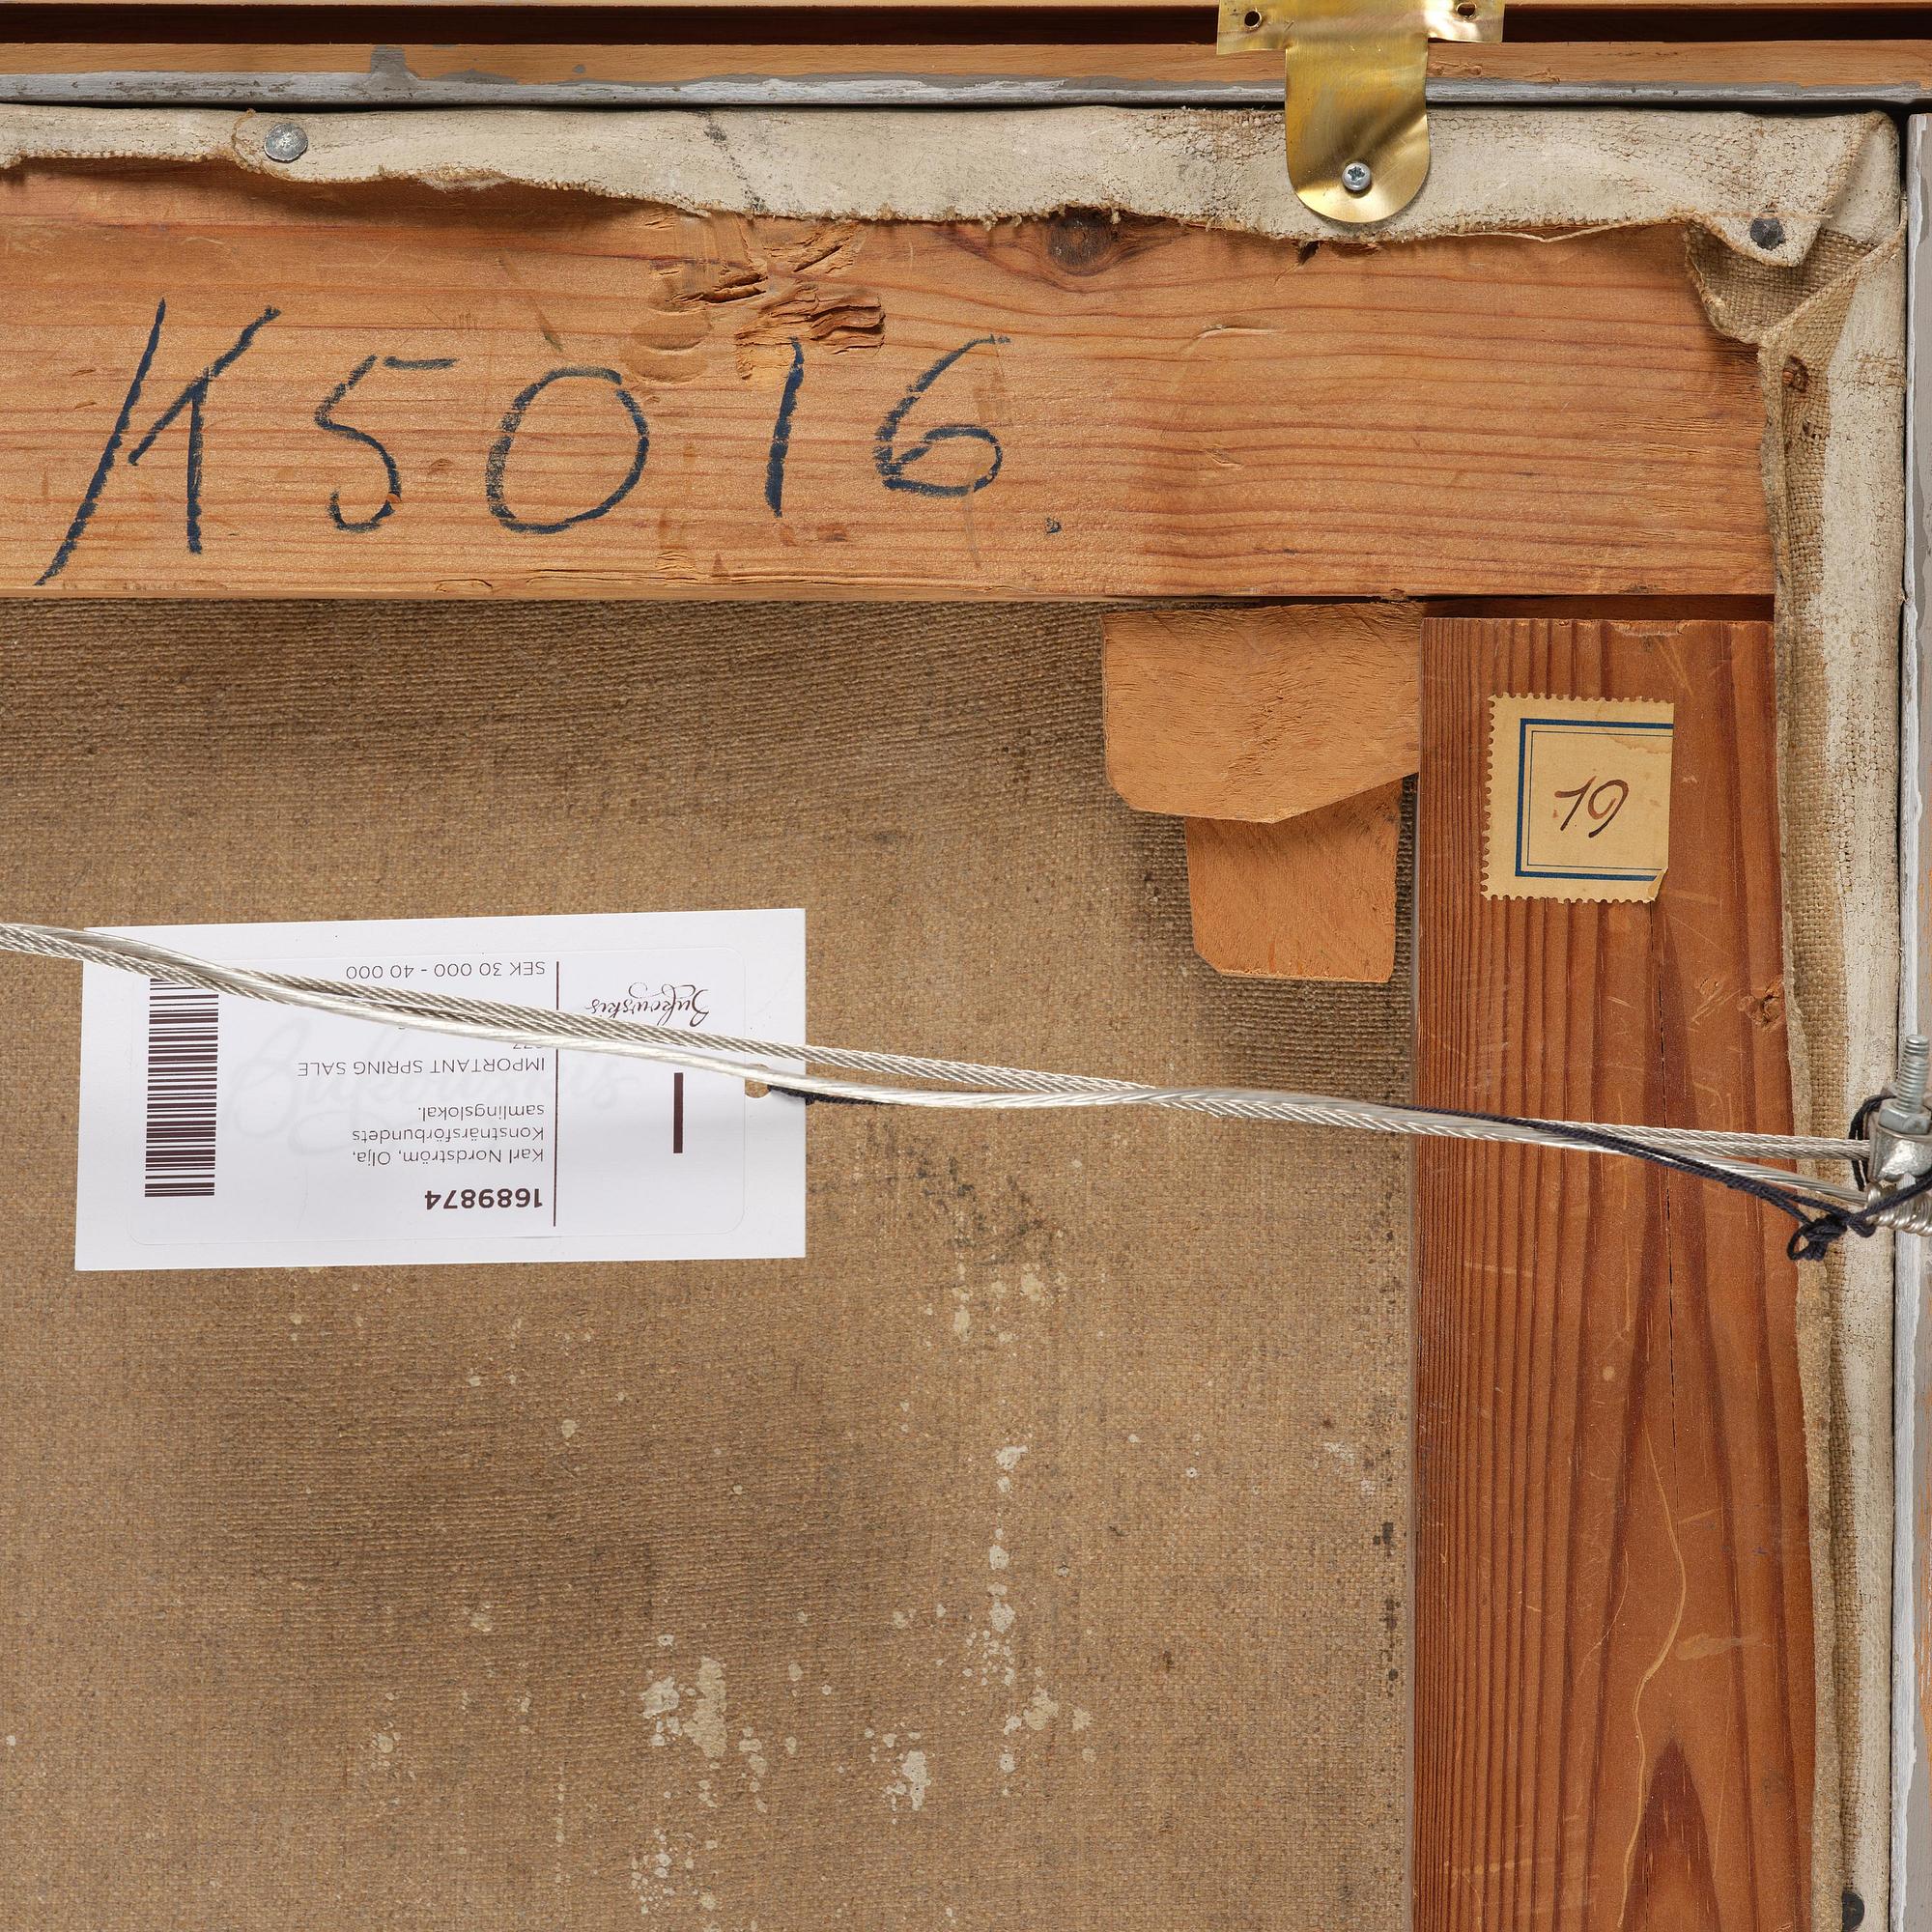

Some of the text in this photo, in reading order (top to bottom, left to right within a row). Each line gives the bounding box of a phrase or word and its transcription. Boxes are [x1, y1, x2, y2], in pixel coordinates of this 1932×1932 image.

[346, 965, 384, 980] 000
[389, 964, 415, 979] 40
[434, 962, 472, 978] 000
[478, 962, 502, 977] 30
[509, 960, 546, 977] SEK
[584, 981, 710, 1028] Bukowskis
[297, 1057, 545, 1077] IMPORTANT SPRING SALE
[417, 1103, 545, 1122] samlingslokal.
[352, 1126, 544, 1145] Konstnärsförbundets
[352, 1148, 544, 1168] Karl Nordström, Olja,
[423, 1187, 544, 1211] 1689874
